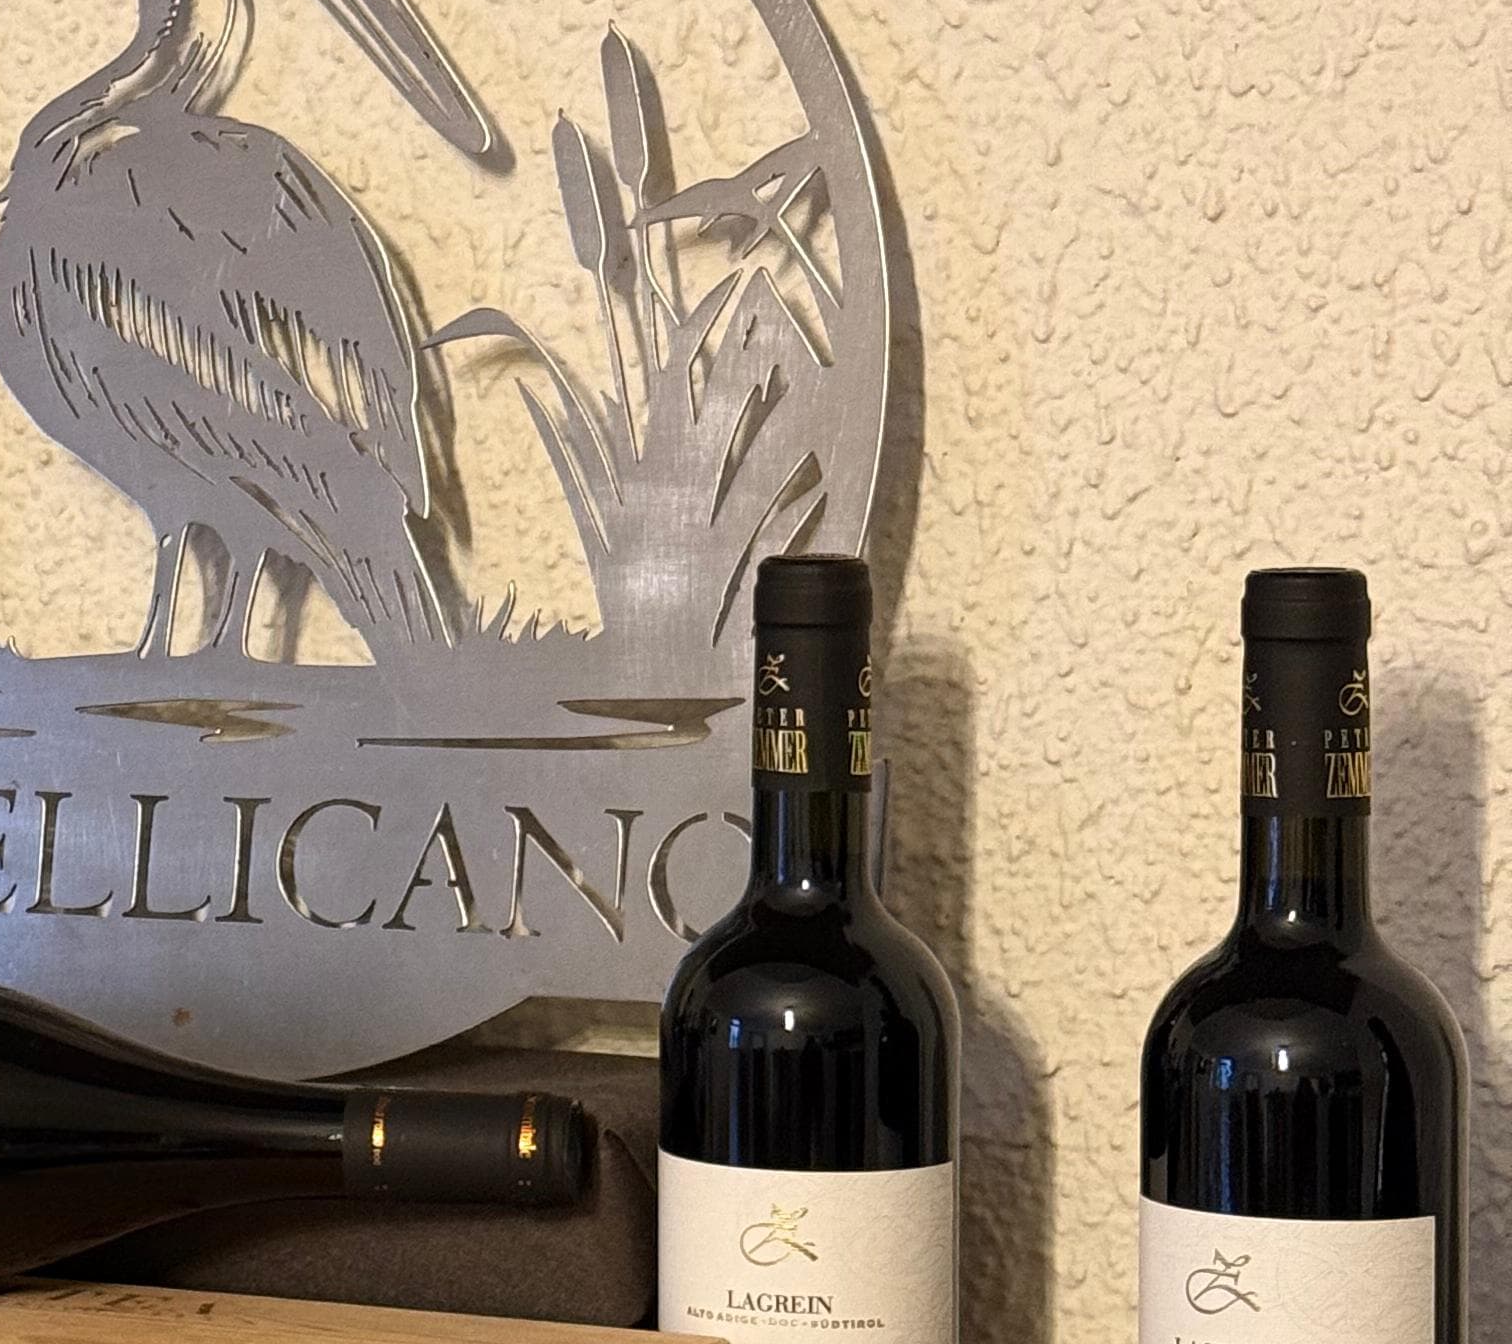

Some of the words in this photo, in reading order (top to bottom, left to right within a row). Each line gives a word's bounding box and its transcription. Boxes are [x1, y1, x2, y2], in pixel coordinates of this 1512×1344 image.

[727, 1290, 834, 1316] LAGREIN
[687, 1305, 714, 1321] ALTO
[716, 1311, 759, 1327] ADIGE
[810, 1316, 885, 1331] SÜDTIROL
